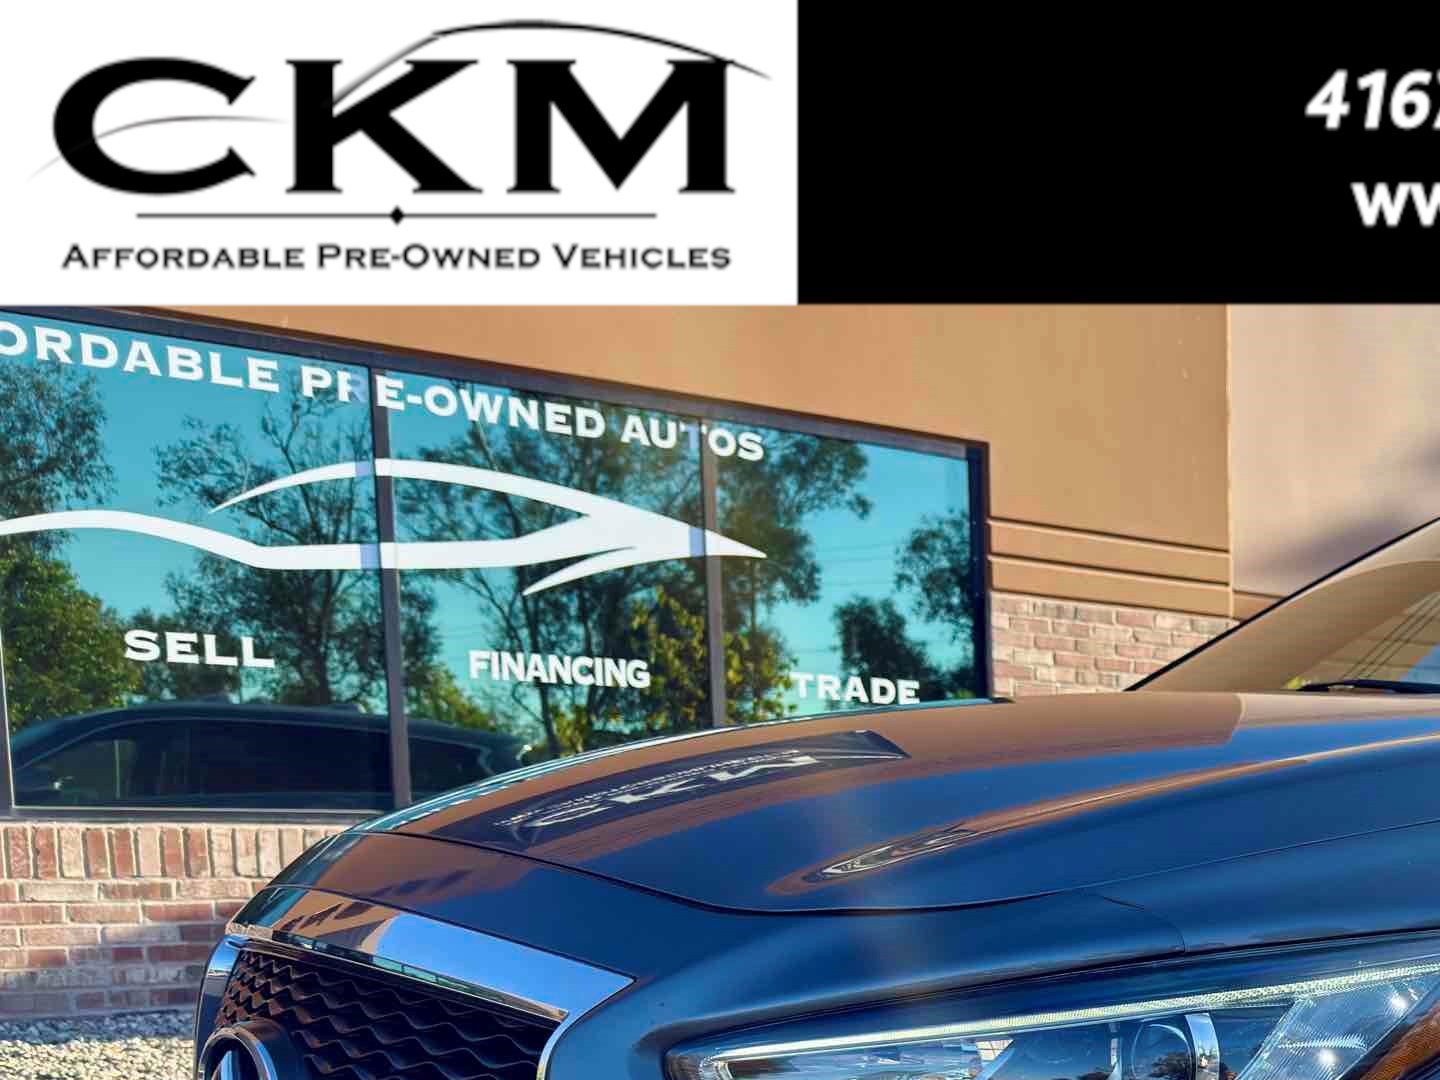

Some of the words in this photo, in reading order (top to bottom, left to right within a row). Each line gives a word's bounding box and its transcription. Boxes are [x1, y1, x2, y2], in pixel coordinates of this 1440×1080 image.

[300, 365, 606, 440] PRE-OWNED
[620, 417, 764, 463] AUTOS
[123, 628, 276, 669] SELL
[467, 649, 652, 689] FINANCING
[791, 671, 921, 705] TRADE
